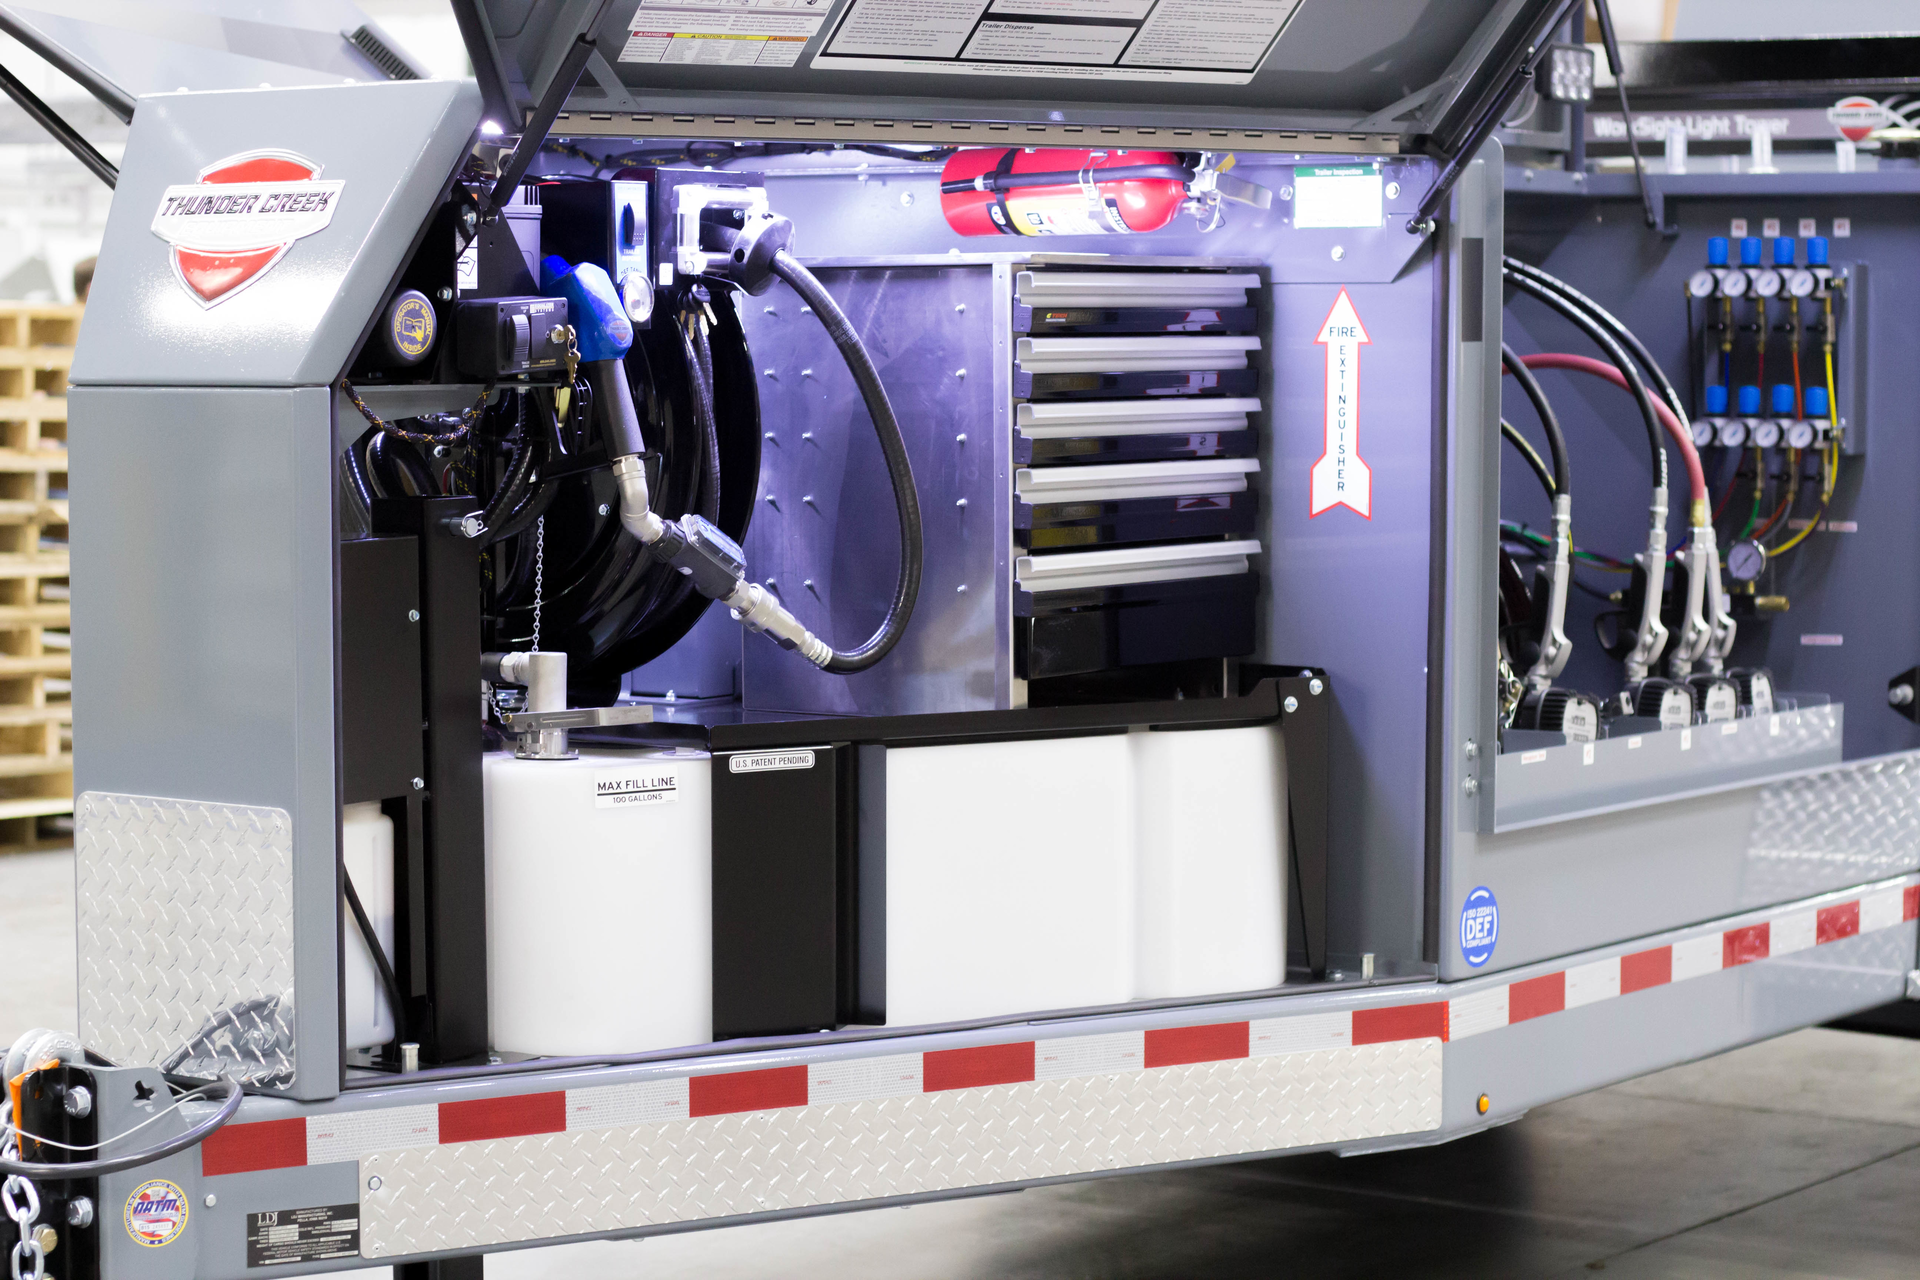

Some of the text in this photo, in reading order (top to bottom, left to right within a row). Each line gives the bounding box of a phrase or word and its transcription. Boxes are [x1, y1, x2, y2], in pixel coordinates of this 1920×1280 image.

[1685, 114, 1730, 140] Light
[1733, 114, 1789, 136] Tower
[1333, 168, 1363, 177] Inspection
[162, 191, 336, 216] THUNDER CREEK
[396, 302, 432, 336] OPERATOR'S MANUAL
[1330, 326, 1356, 338] FIRE
[402, 341, 422, 352] INSIDE
[1337, 345, 1347, 492] EXTINGUISHER
[735, 754, 809, 768] U.S. PATENT PENDING
[598, 776, 675, 792] MAX FILL LINE
[628, 793, 662, 802] GALLONS
[1467, 906, 1492, 918] ISO 22241
[1466, 916, 1493, 941] DEF
[1466, 936, 1492, 948] COMPLIANT
[134, 1199, 178, 1214] NATM
[258, 1212, 279, 1226] LDJ
